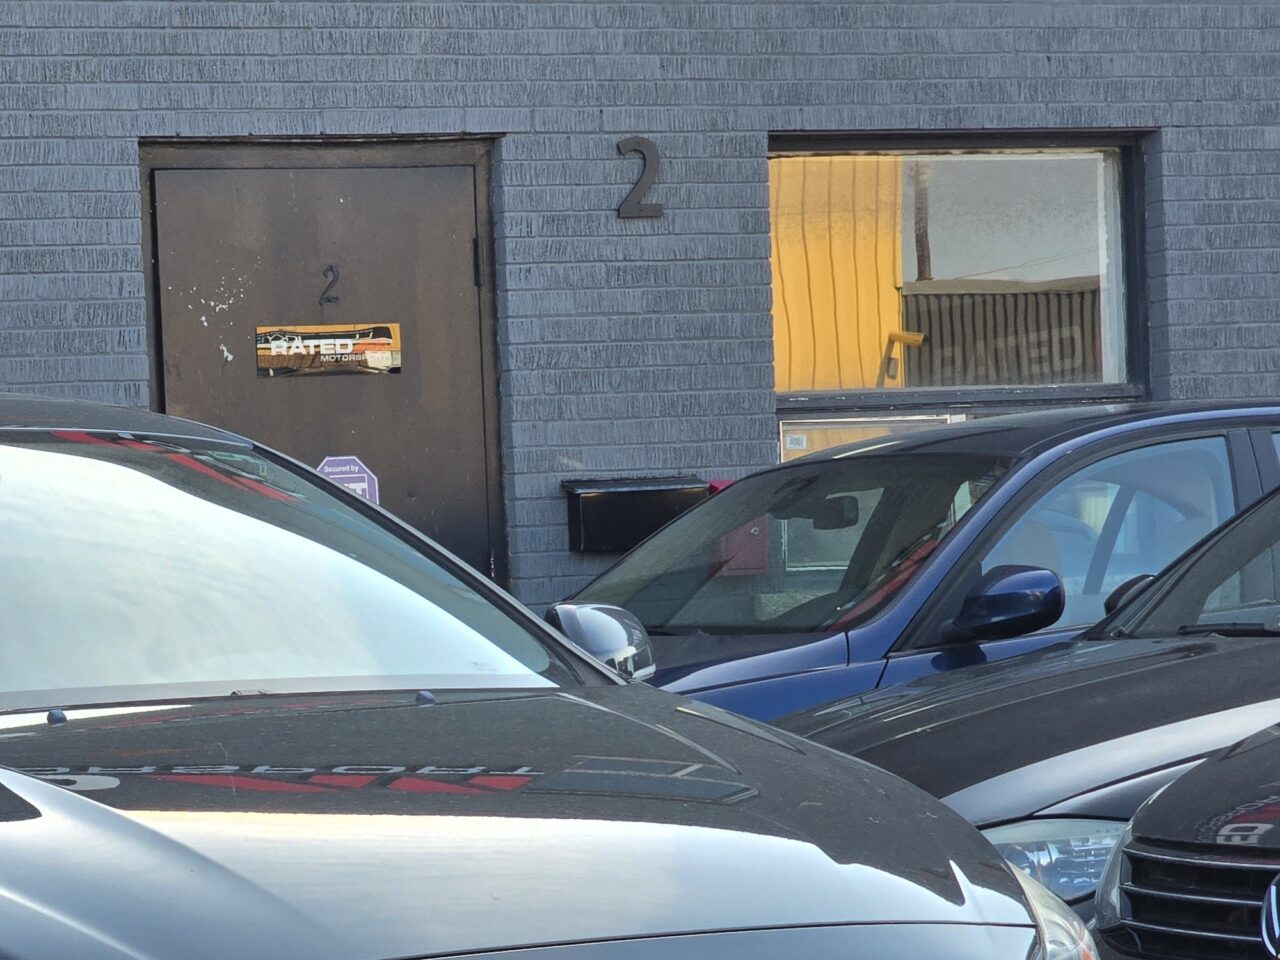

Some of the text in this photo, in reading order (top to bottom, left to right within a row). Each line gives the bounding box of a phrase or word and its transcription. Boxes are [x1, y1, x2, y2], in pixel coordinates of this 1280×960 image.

[616, 136, 664, 219] 2
[319, 264, 340, 306] 2
[270, 337, 354, 356] RATED
[323, 464, 359, 473] Secured by
